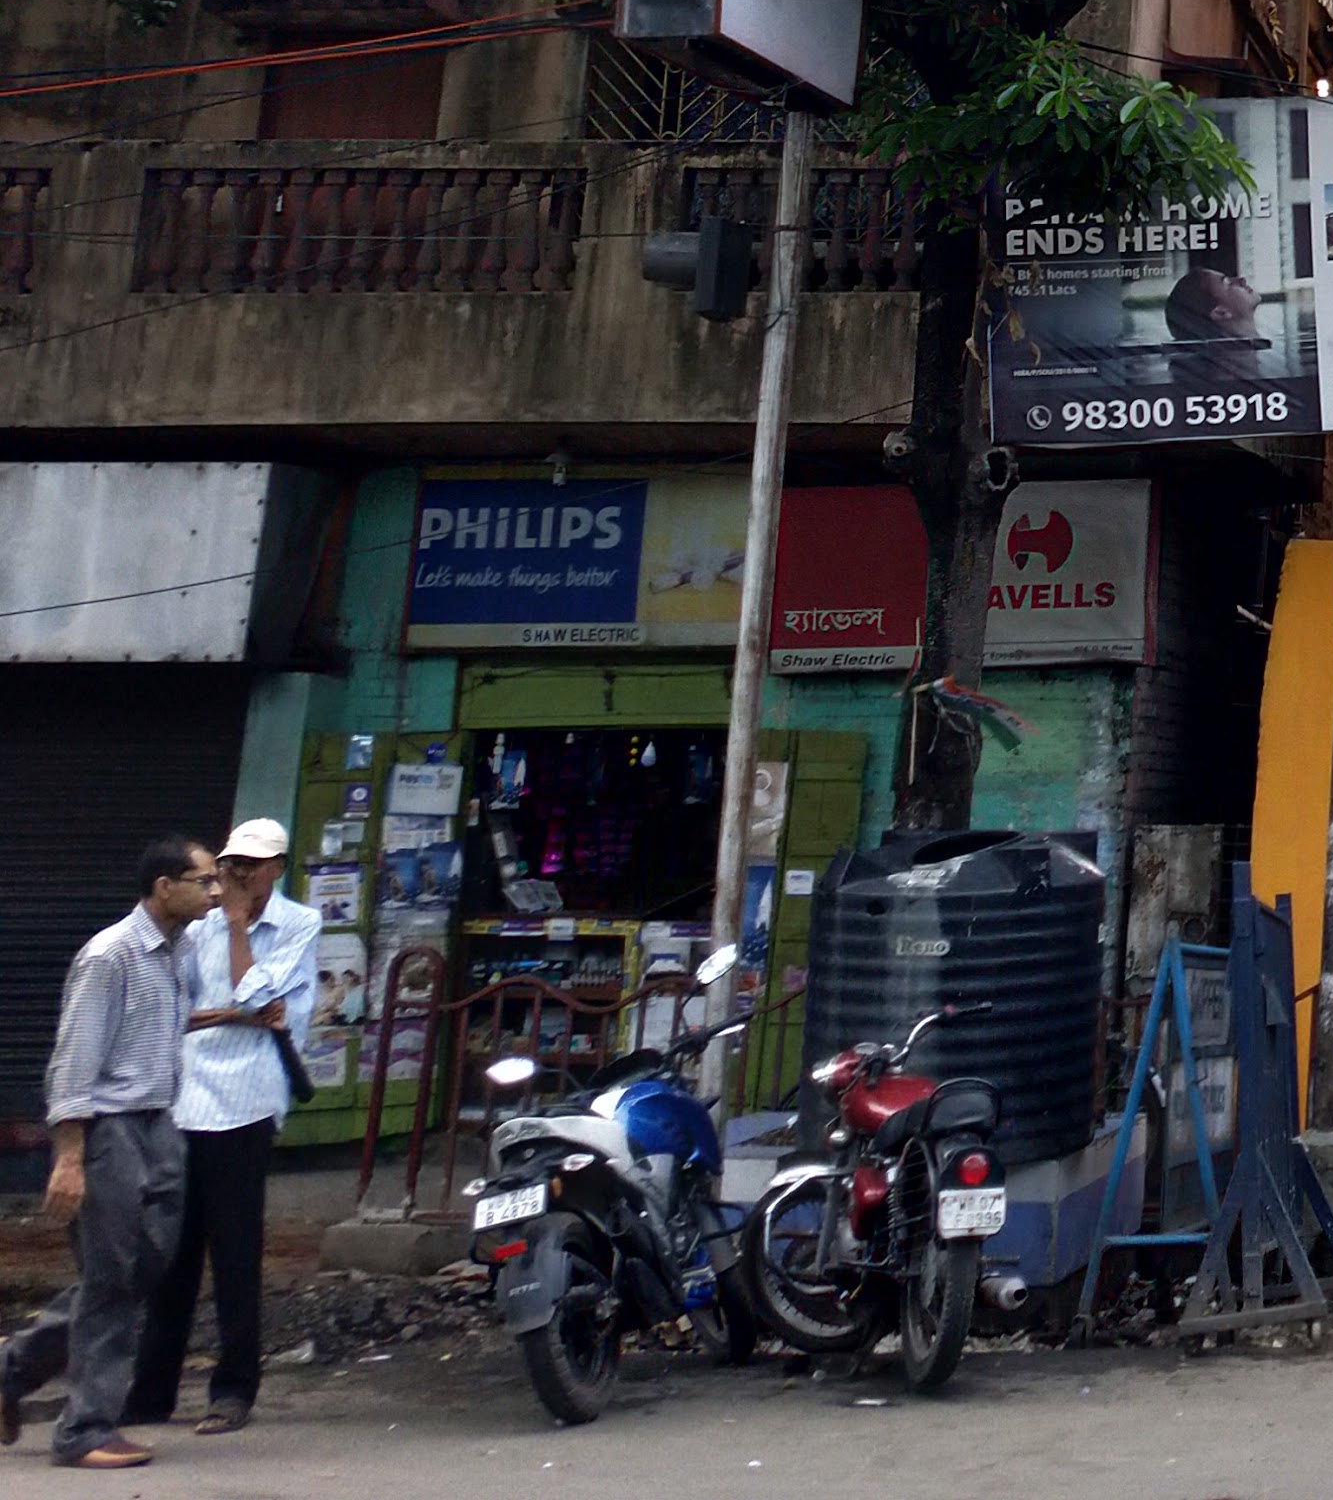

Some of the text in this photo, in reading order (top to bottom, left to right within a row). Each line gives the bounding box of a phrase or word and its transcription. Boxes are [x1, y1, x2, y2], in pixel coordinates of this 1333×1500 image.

[1162, 193, 1271, 221] HOME
[1006, 222, 1219, 256] ENDS HERE!
[1047, 269, 1088, 280] homes
[1091, 266, 1140, 280] starting
[1142, 265, 1172, 277] from
[1050, 285, 1077, 296] Lacs
[1061, 391, 1289, 431] 98300 53918
[419, 505, 622, 550] PHILIPS
[455, 565, 503, 588] make
[508, 565, 561, 593] things
[986, 582, 1115, 610] AVELLS
[522, 628, 639, 643] SHAW ELECTRIC
[781, 653, 896, 668] Shaw Electric
